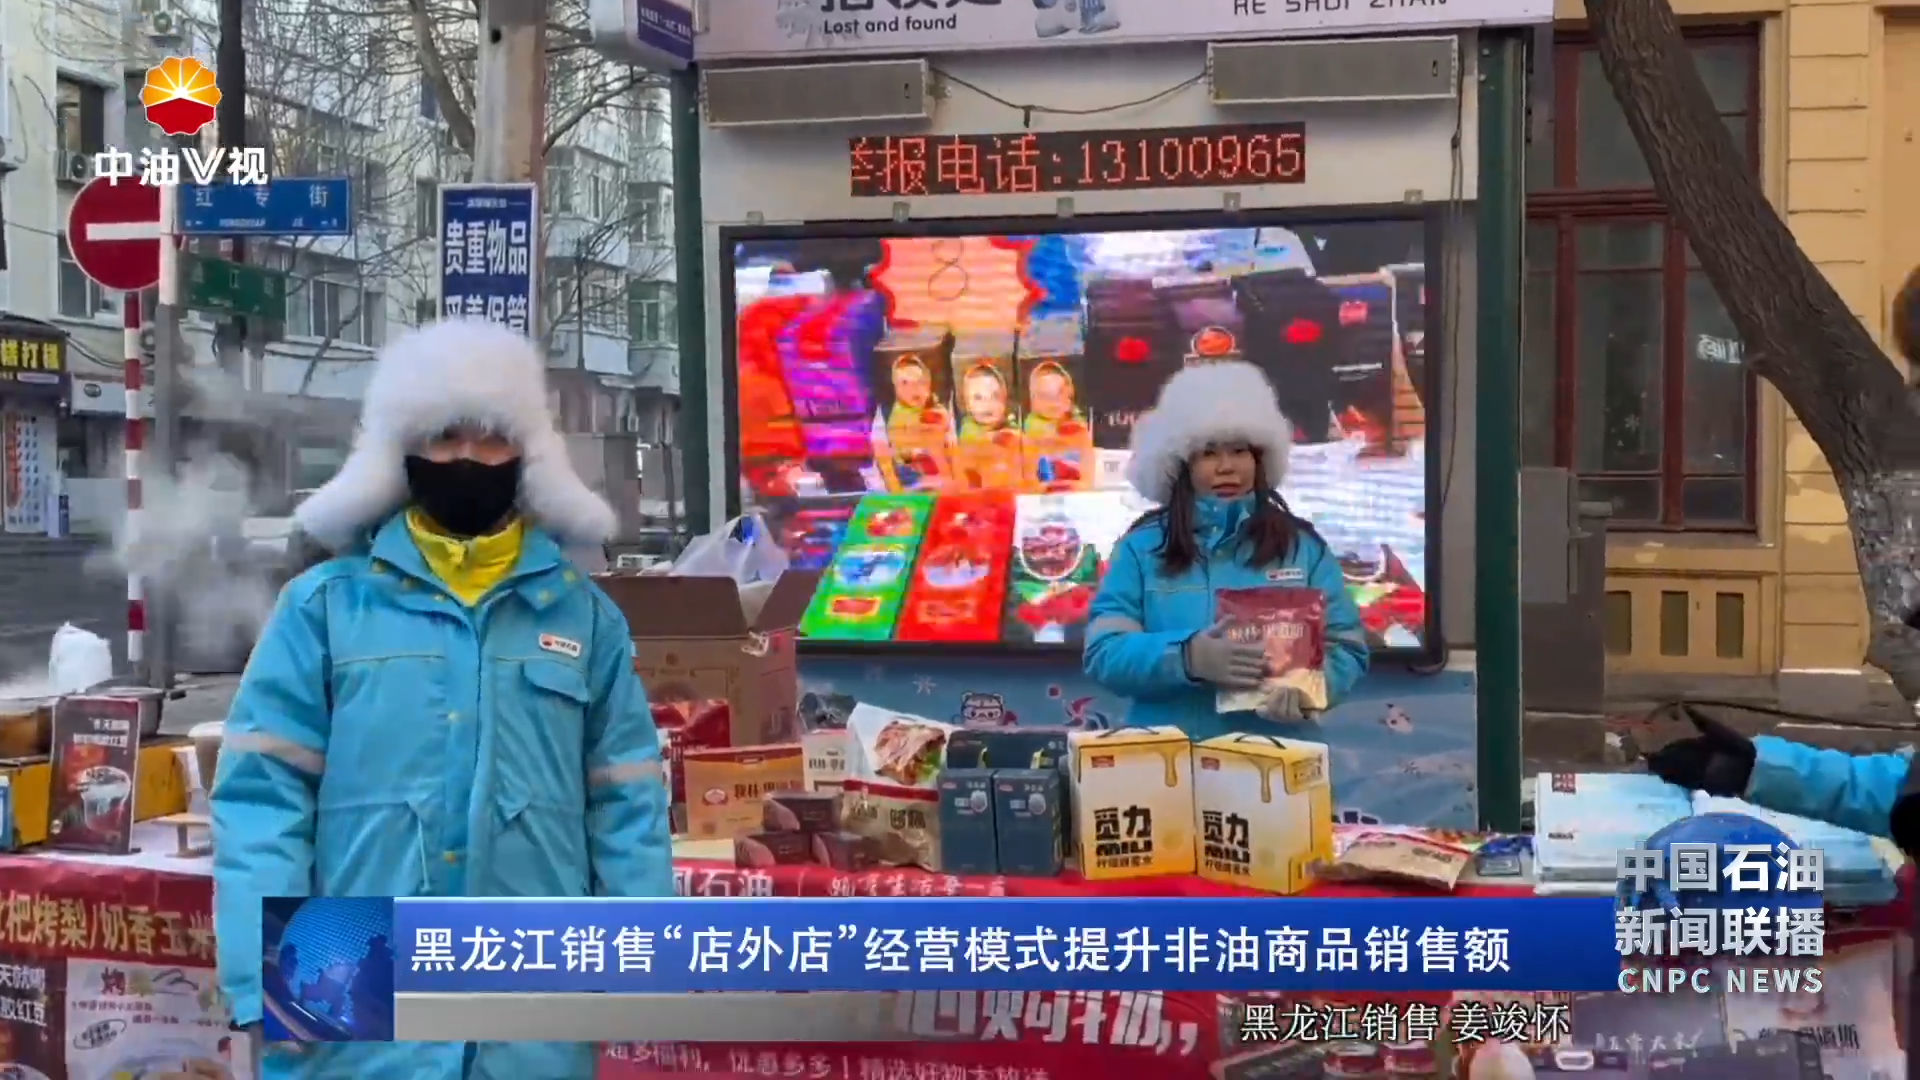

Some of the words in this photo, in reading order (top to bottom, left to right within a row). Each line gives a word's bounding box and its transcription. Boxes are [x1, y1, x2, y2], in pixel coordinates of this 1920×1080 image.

[824, 19, 859, 35] Lost
[865, 16, 899, 33] and
[906, 14, 958, 31] found
[445, 219, 527, 275] 贵重物品
